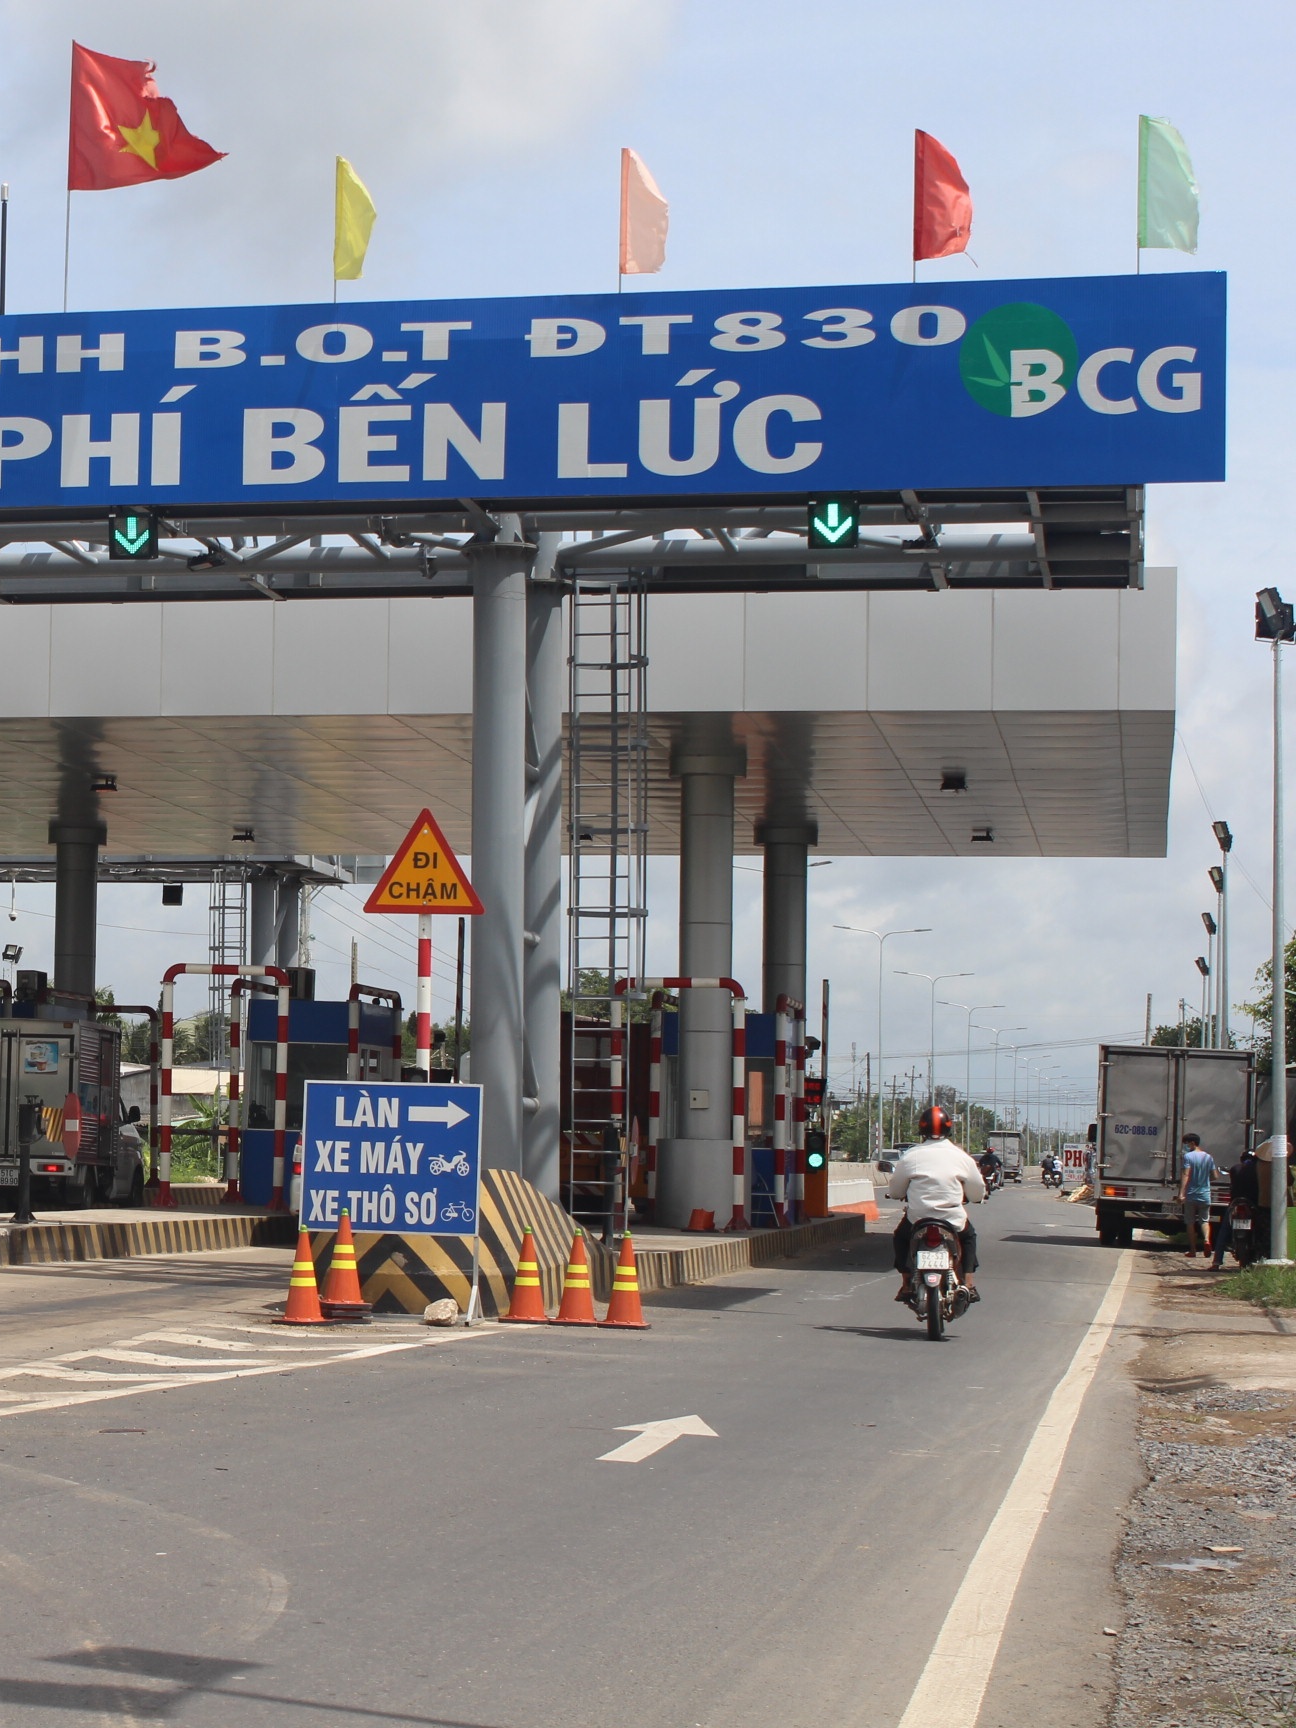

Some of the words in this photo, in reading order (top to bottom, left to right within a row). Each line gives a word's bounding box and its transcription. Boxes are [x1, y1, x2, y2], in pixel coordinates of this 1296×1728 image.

[174, 321, 473, 369] B.O.T
[524, 305, 967, 358] ĐT830
[1010, 345, 1202, 418] BCG
[242, 372, 507, 486] BẾN
[557, 368, 823, 479] LỨC
[413, 852, 438, 869] ĐI
[388, 878, 458, 902] CHẬM
[335, 1090, 400, 1128] LÀN
[314, 1140, 350, 1173] XE
[360, 1135, 425, 1175] MÁY
[308, 1189, 340, 1222] XE
[347, 1184, 396, 1224] THÔ
[405, 1188, 438, 1225] SƠ
